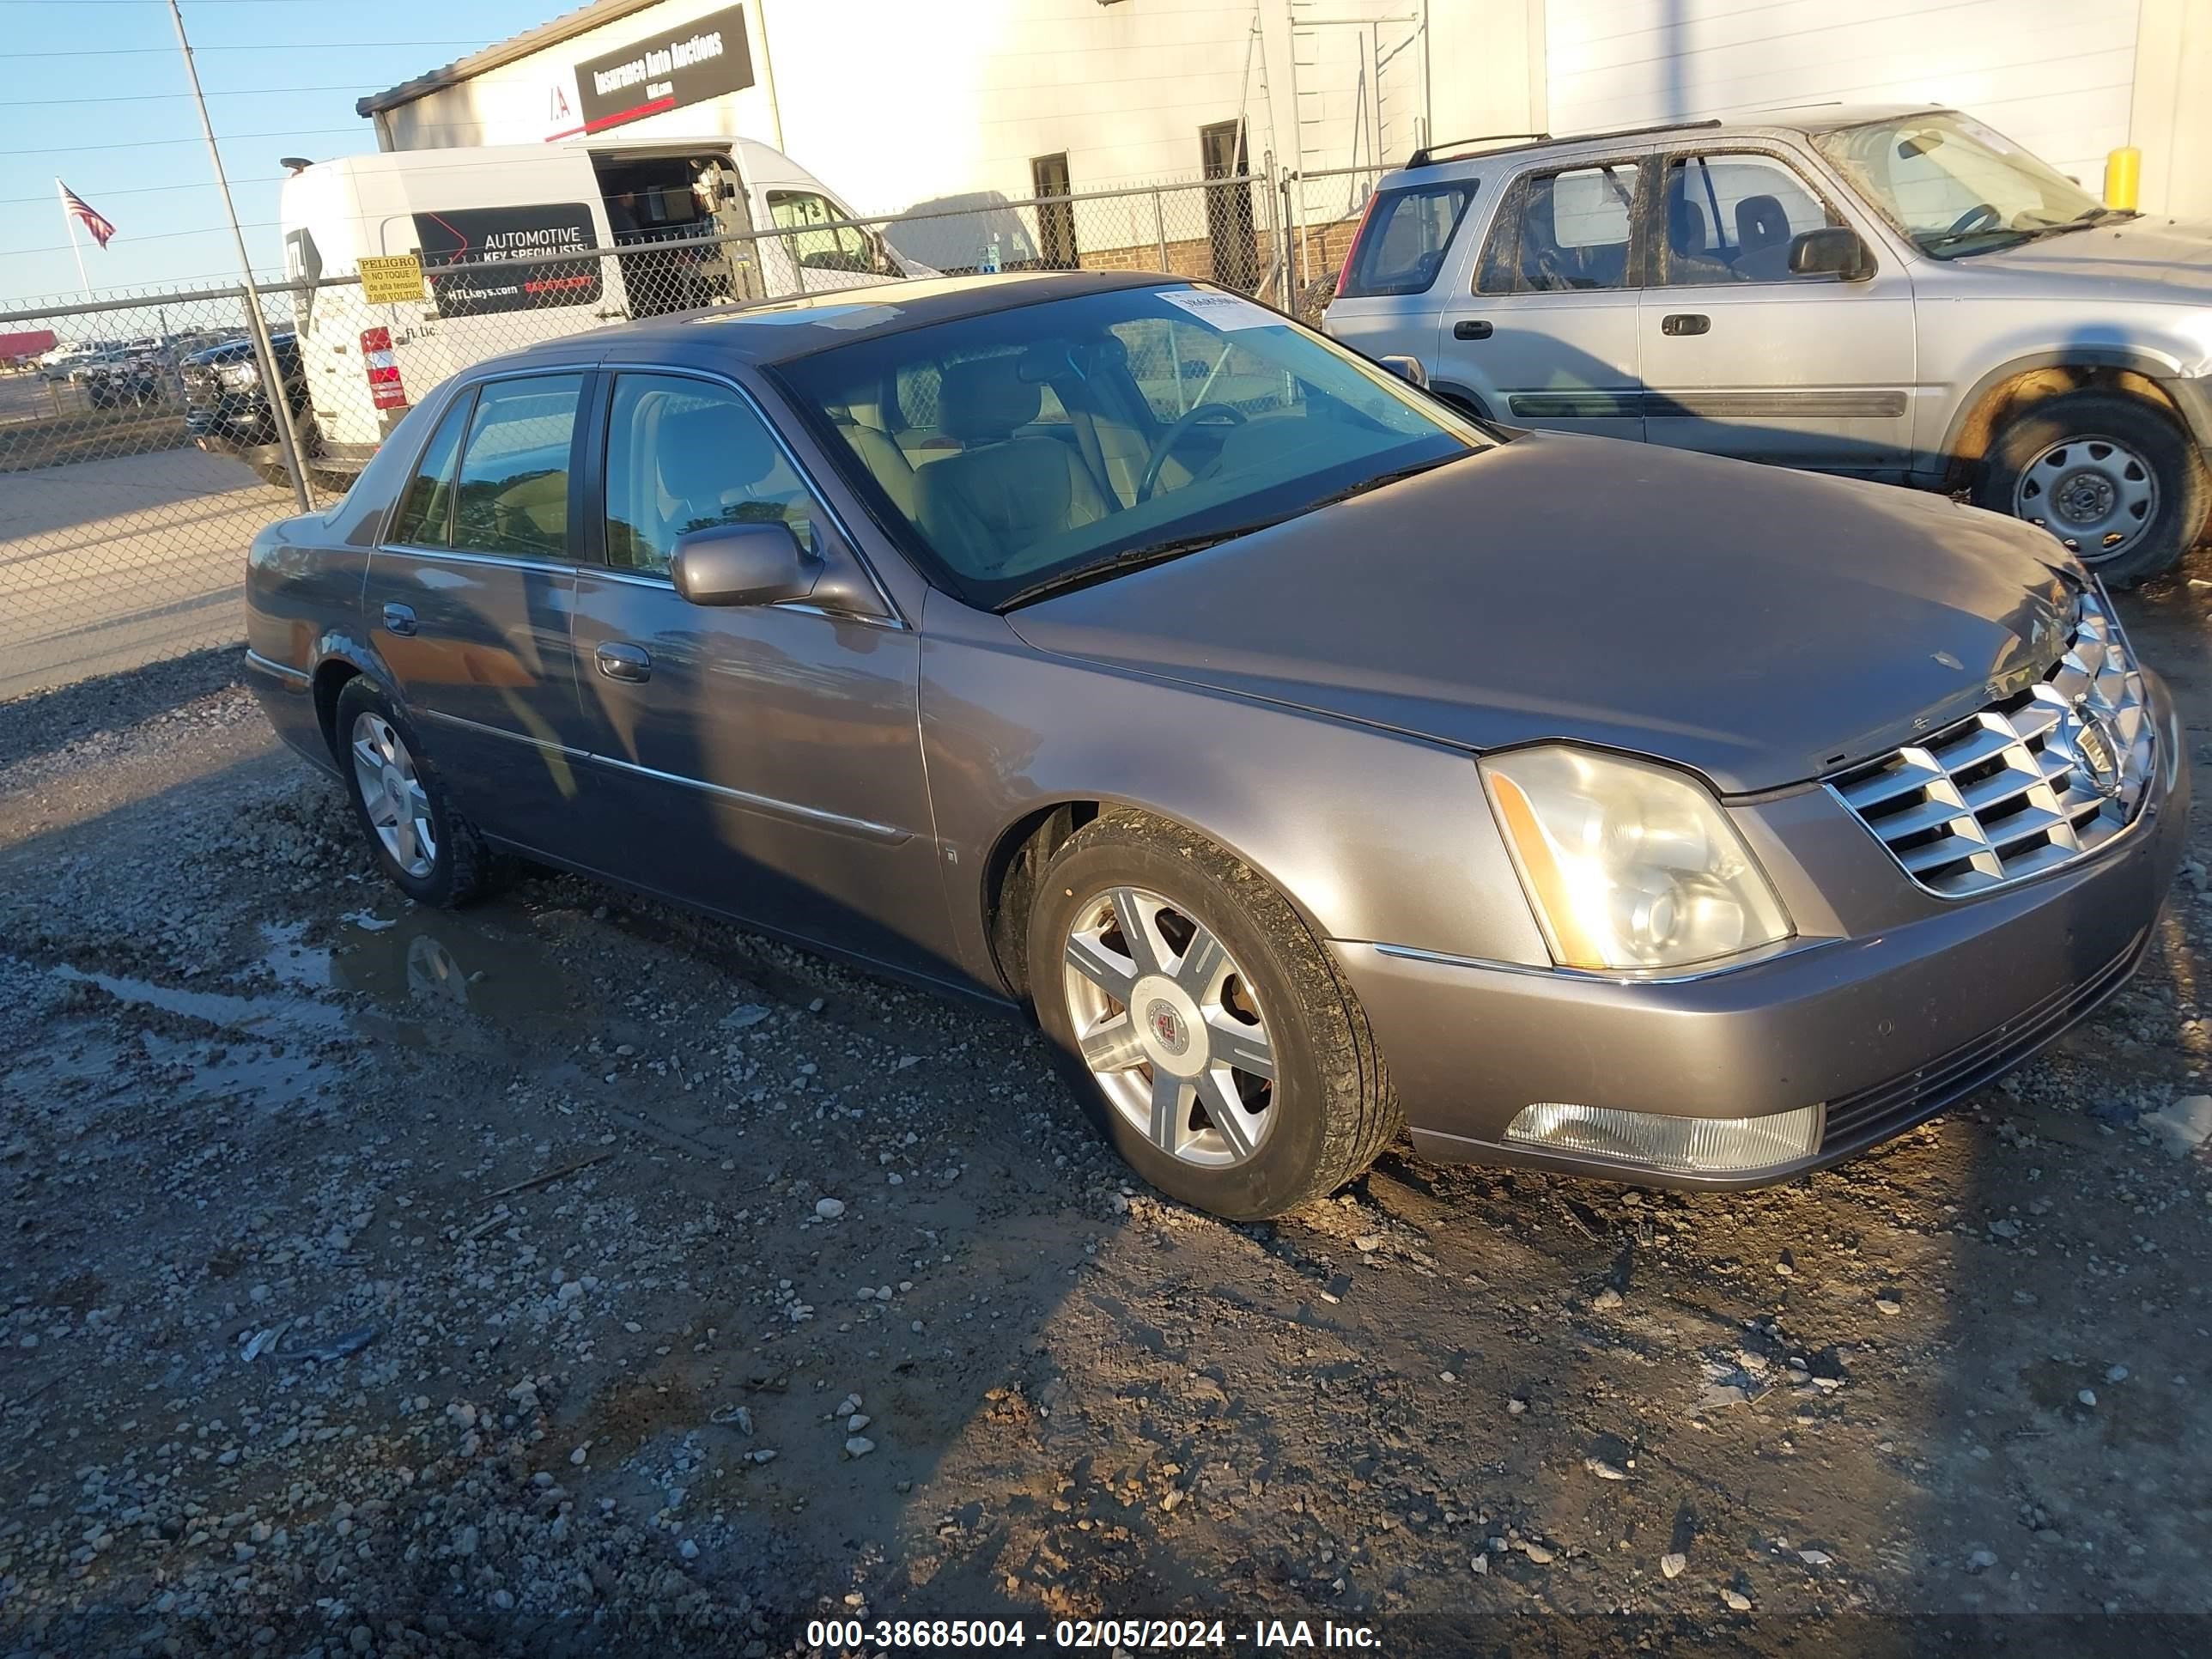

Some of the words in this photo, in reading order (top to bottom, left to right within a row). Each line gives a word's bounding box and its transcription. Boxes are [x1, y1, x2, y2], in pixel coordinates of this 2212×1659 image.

[593, 58, 647, 95] Insurance
[646, 49, 672, 78] Auto
[671, 31, 724, 70] Auctions
[485, 227, 581, 250] AUTOMOTIVE
[483, 250, 507, 263] KEY
[511, 243, 585, 259] SPECIALISTS
[362, 257, 416, 270] PELIGRO
[372, 271, 383, 281] NO
[384, 270, 410, 279] TOQUE
[368, 283, 378, 292] de
[380, 283, 392, 291] alta
[393, 281, 420, 289] tension
[447, 286, 519, 301] HTLkeys.com
[388, 289, 423, 301] VOLTIOS
